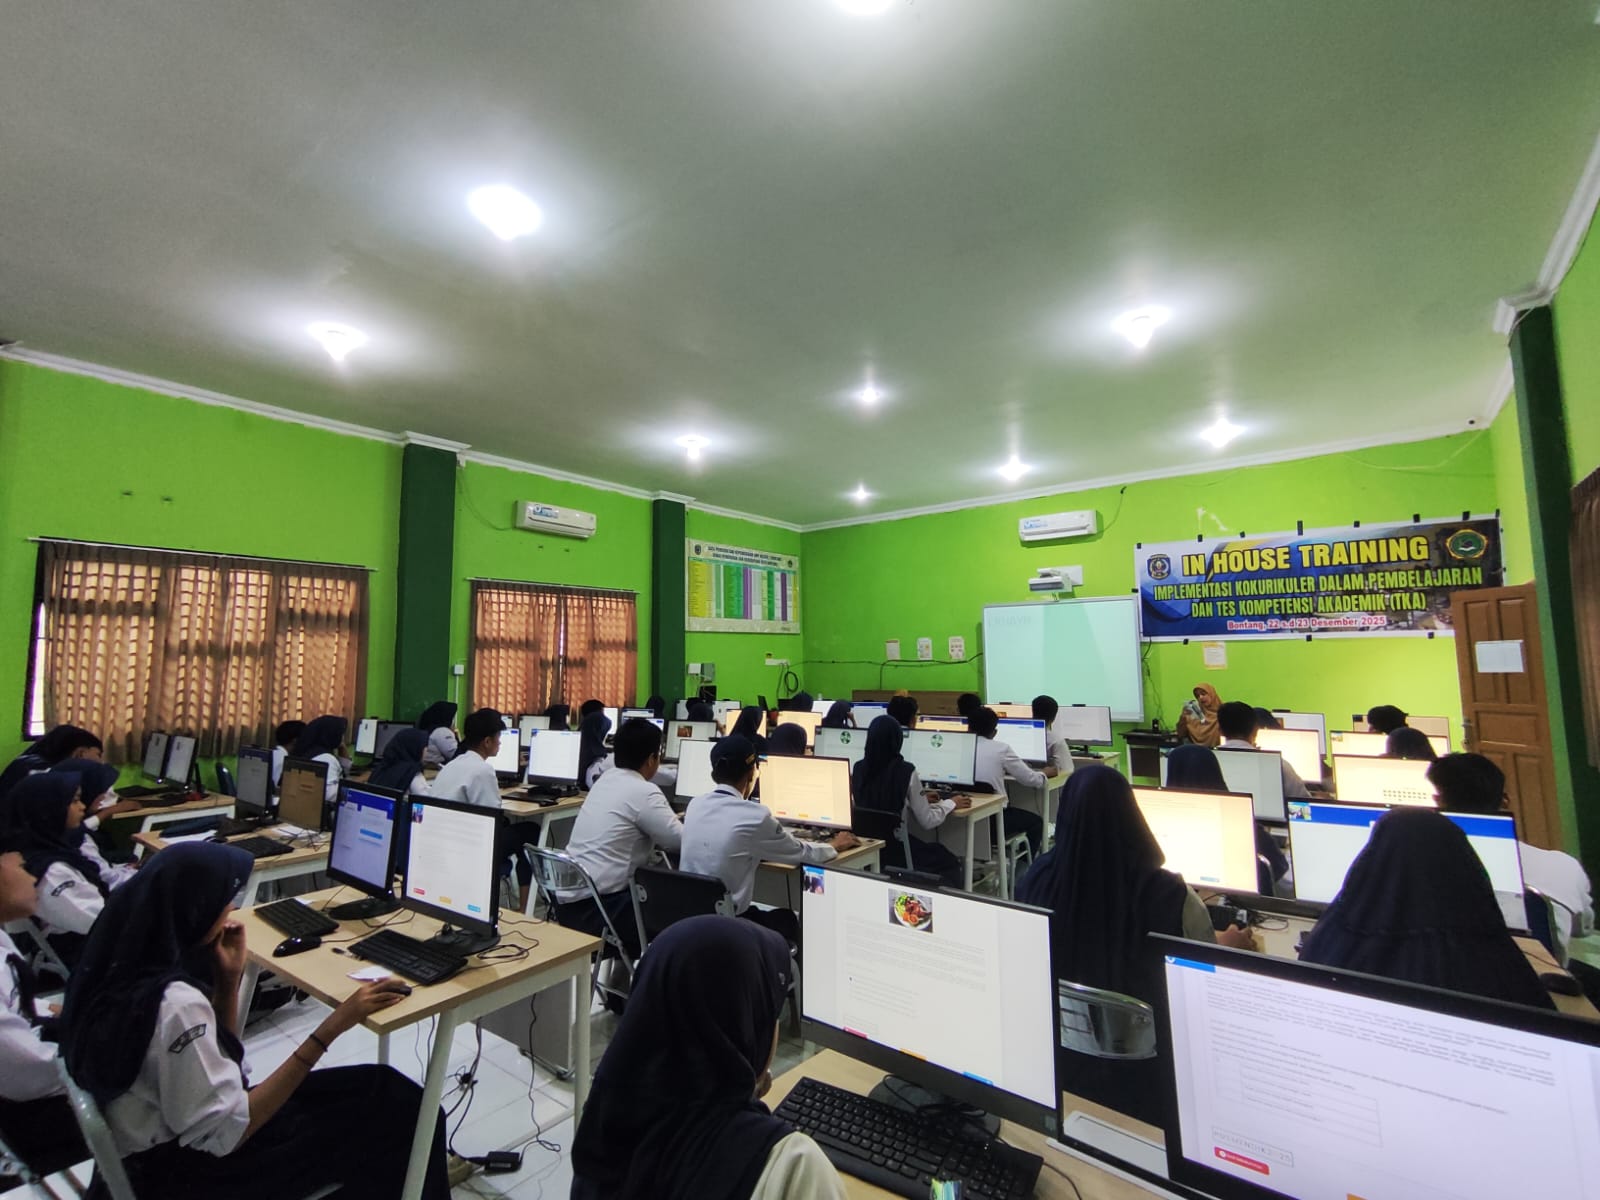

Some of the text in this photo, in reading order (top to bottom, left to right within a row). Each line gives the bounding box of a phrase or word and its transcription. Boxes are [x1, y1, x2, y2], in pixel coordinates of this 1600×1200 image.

[1182, 536, 1429, 576] IN HOUSE TRAINING
[1154, 567, 1482, 601] IMPLEMENTASI KOKURIKULER DALAM PEMBELAJARAN
[1191, 592, 1426, 617] DAN TES KOMPETENSI AKADEMIK (TKA)
[1227, 620, 1266, 631] Bontang,
[1268, 619, 1279, 629] 22
[1297, 618, 1309, 628] 23
[1311, 616, 1358, 627] Desember
[1361, 616, 1386, 626] 2025
